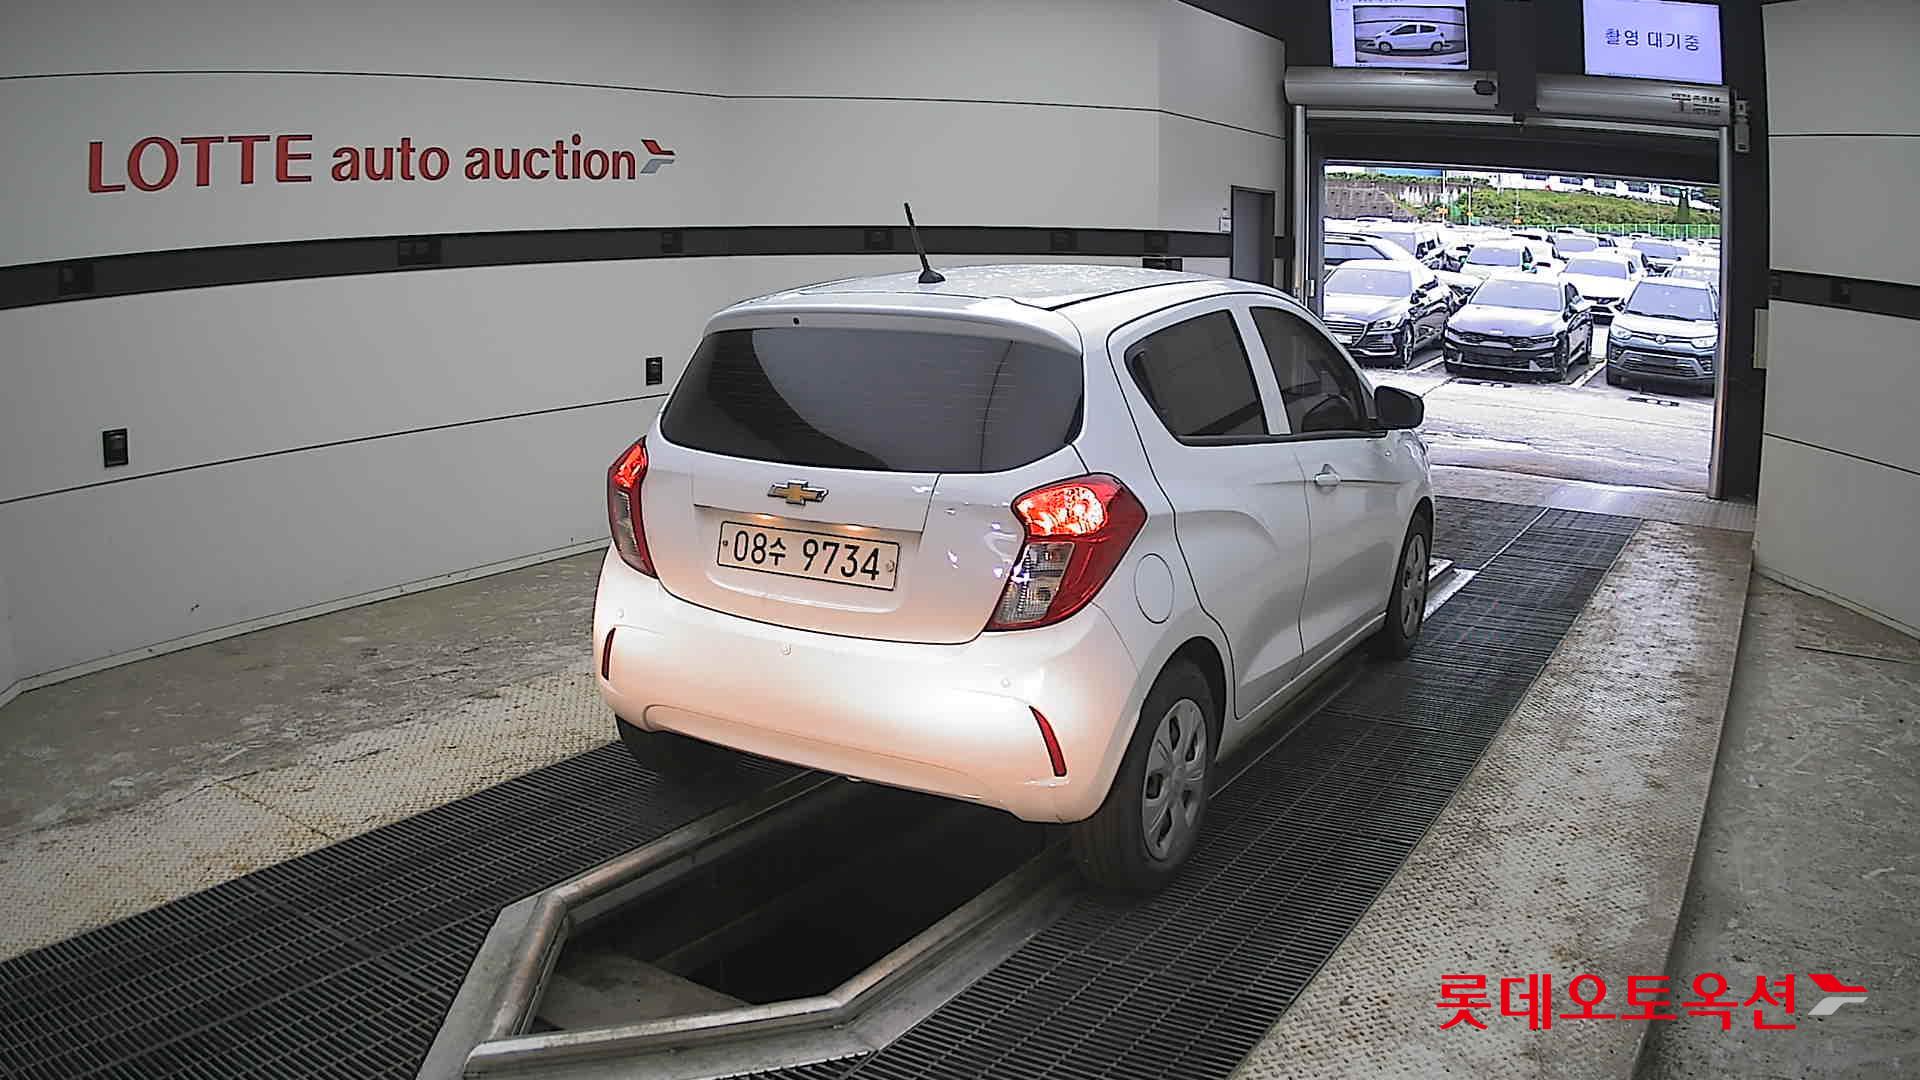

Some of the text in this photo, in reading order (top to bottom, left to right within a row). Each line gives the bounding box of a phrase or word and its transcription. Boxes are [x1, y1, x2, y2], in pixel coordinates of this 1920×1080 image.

[1647, 31, 1700, 52] 대기중
[88, 133, 636, 194] LOTTE auto auction
[733, 530, 880, 581] 08수 9734
